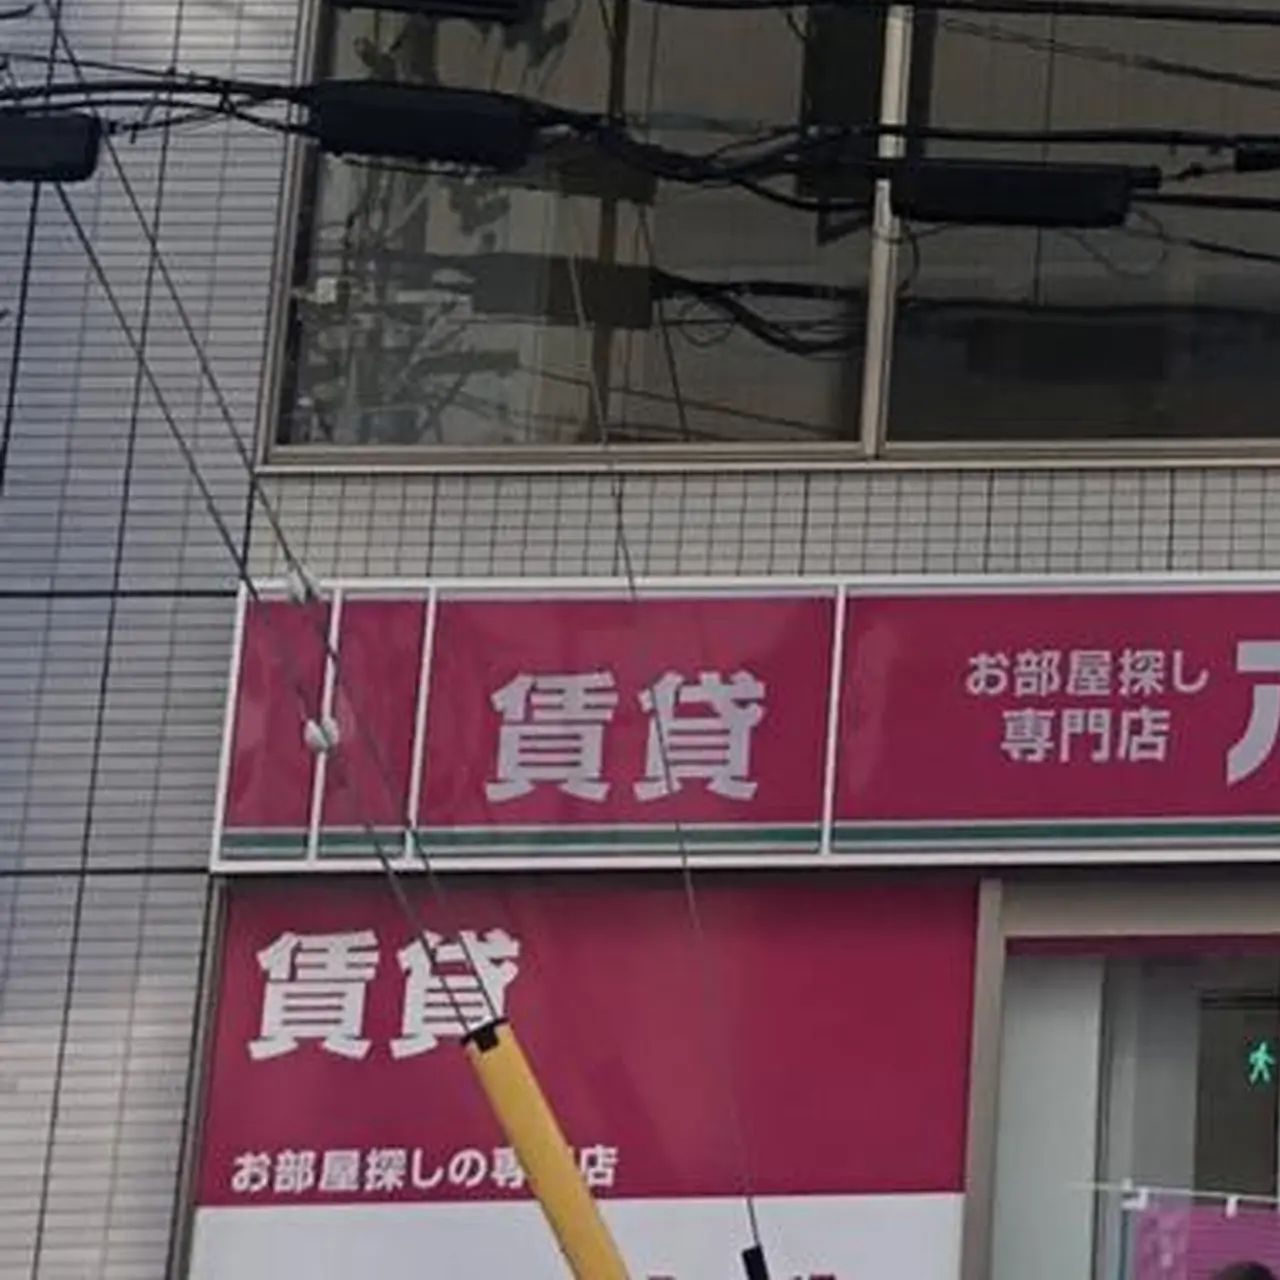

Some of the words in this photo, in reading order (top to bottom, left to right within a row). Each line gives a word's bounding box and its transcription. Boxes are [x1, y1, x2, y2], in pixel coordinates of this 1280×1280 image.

[964, 649, 1209, 699] お部屋探し
[485, 670, 766, 803] 賃貸
[1000, 707, 1171, 763] 専門店
[248, 927, 521, 1061] 賃貸
[230, 1144, 619, 1193] お部屋探しの専店
